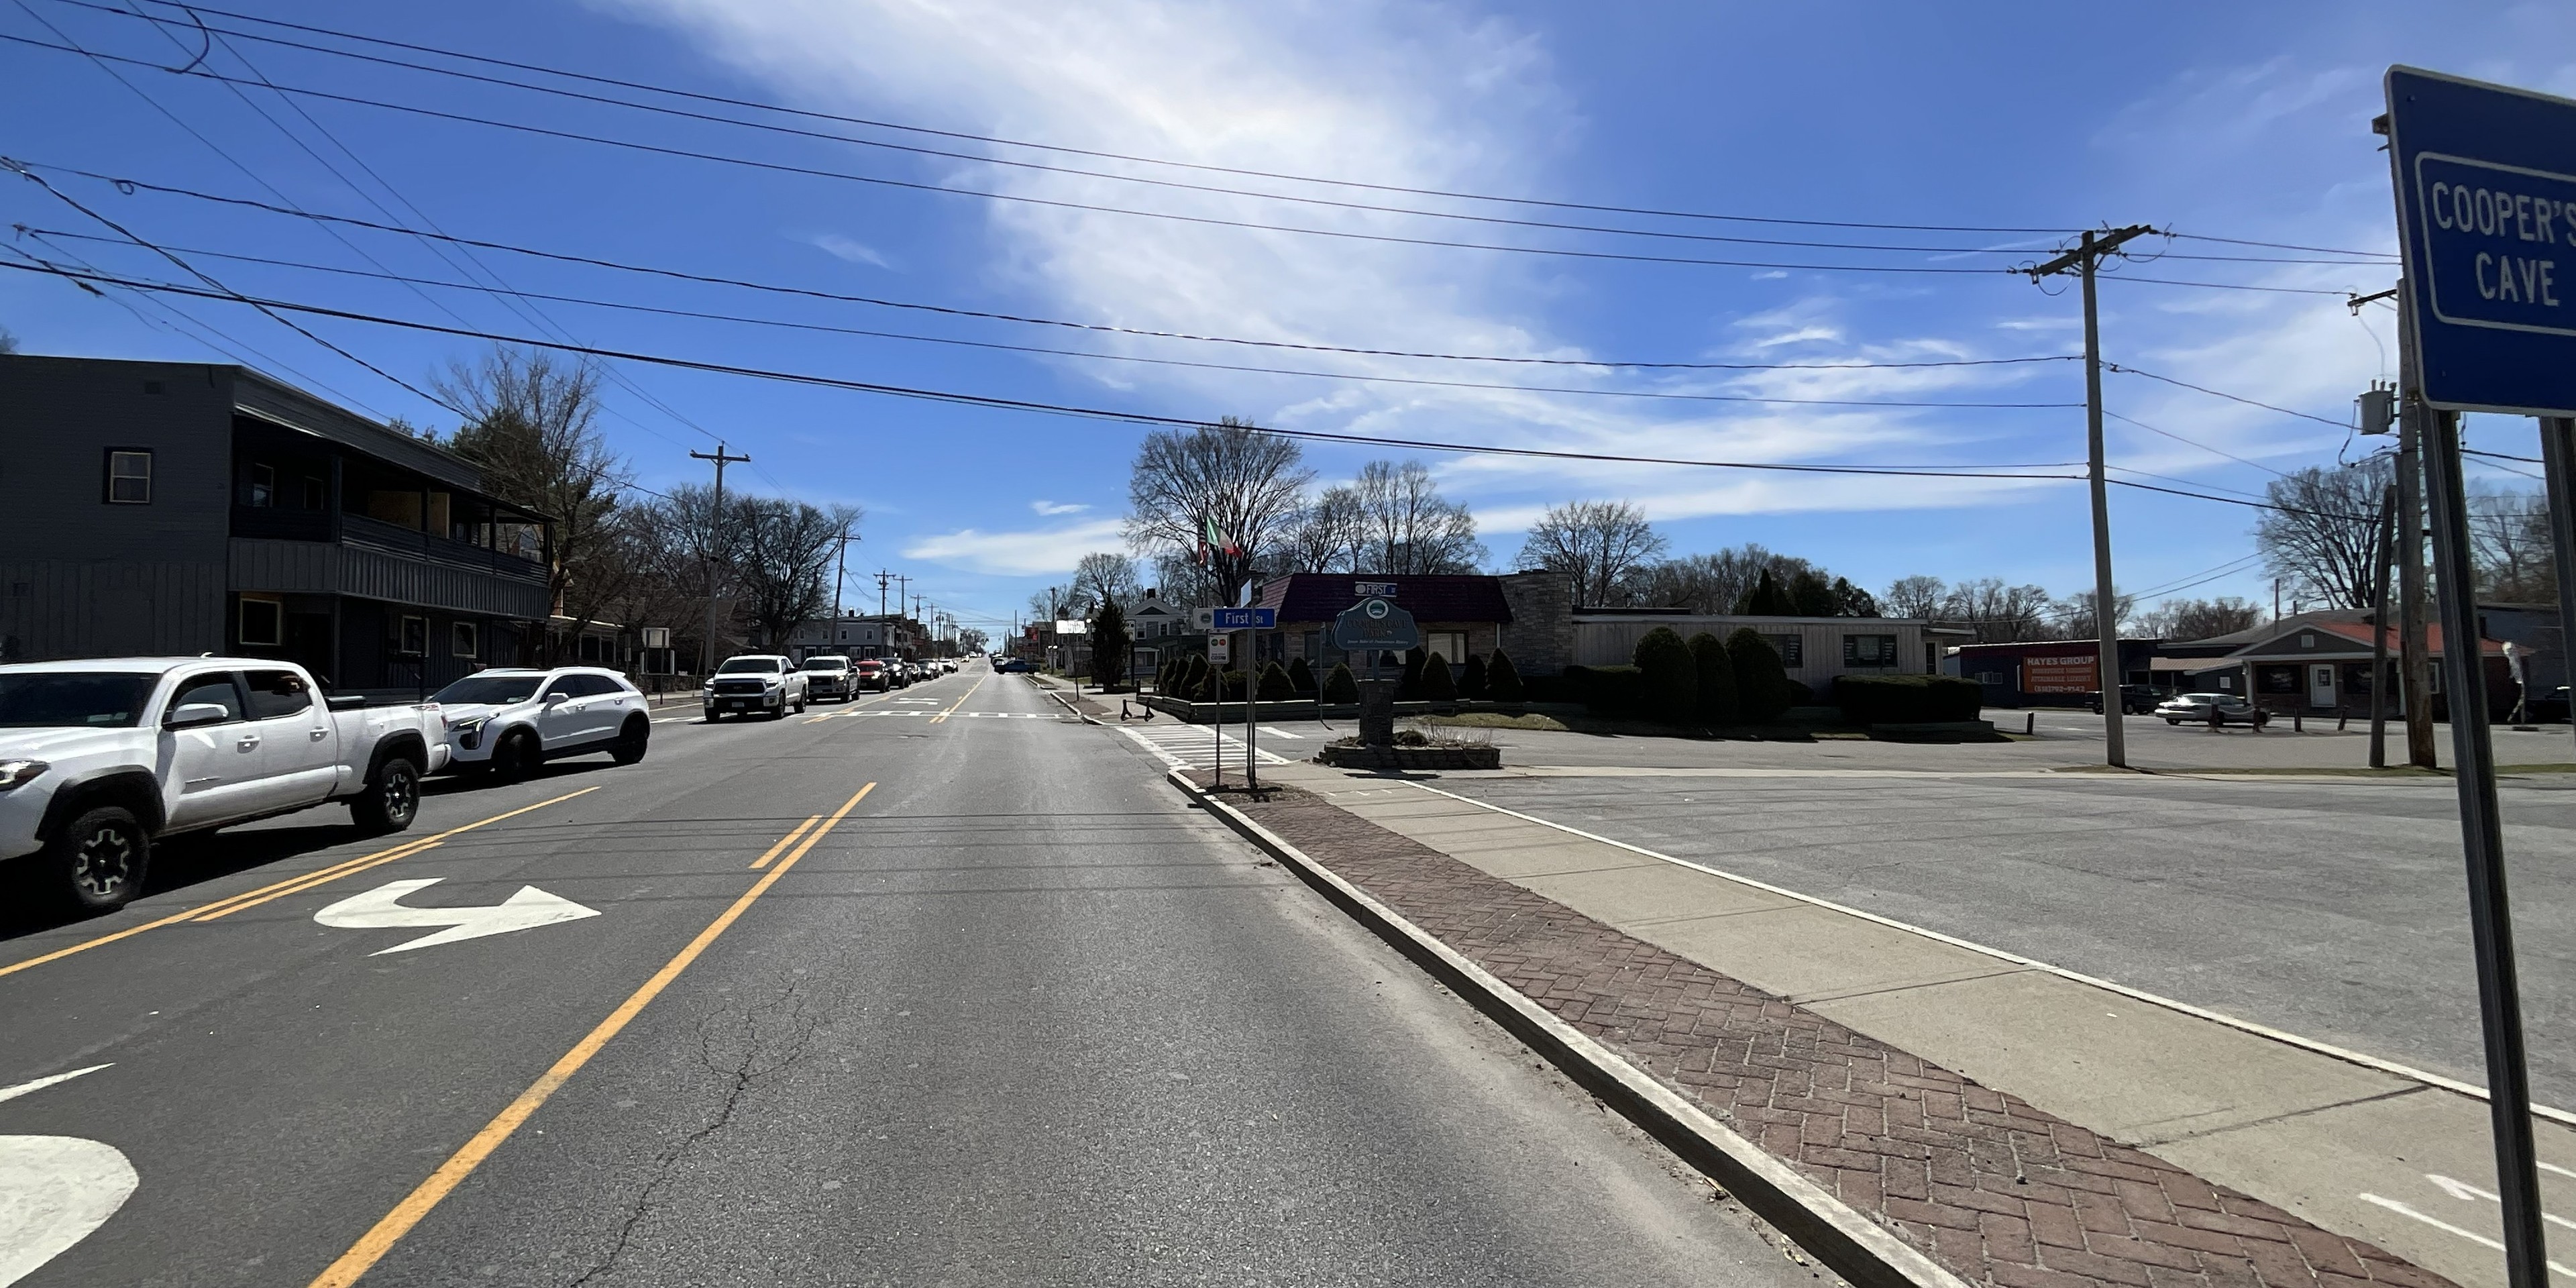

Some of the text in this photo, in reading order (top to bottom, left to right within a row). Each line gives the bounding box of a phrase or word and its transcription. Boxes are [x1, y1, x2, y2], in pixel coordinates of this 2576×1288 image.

[2432, 181, 2576, 247] COOPER'S
[2475, 251, 2561, 307] CAVE
[1366, 584, 1387, 595] FIRST
[1226, 612, 1264, 624] First St
[2027, 656, 2094, 665] HAYES GROUP
